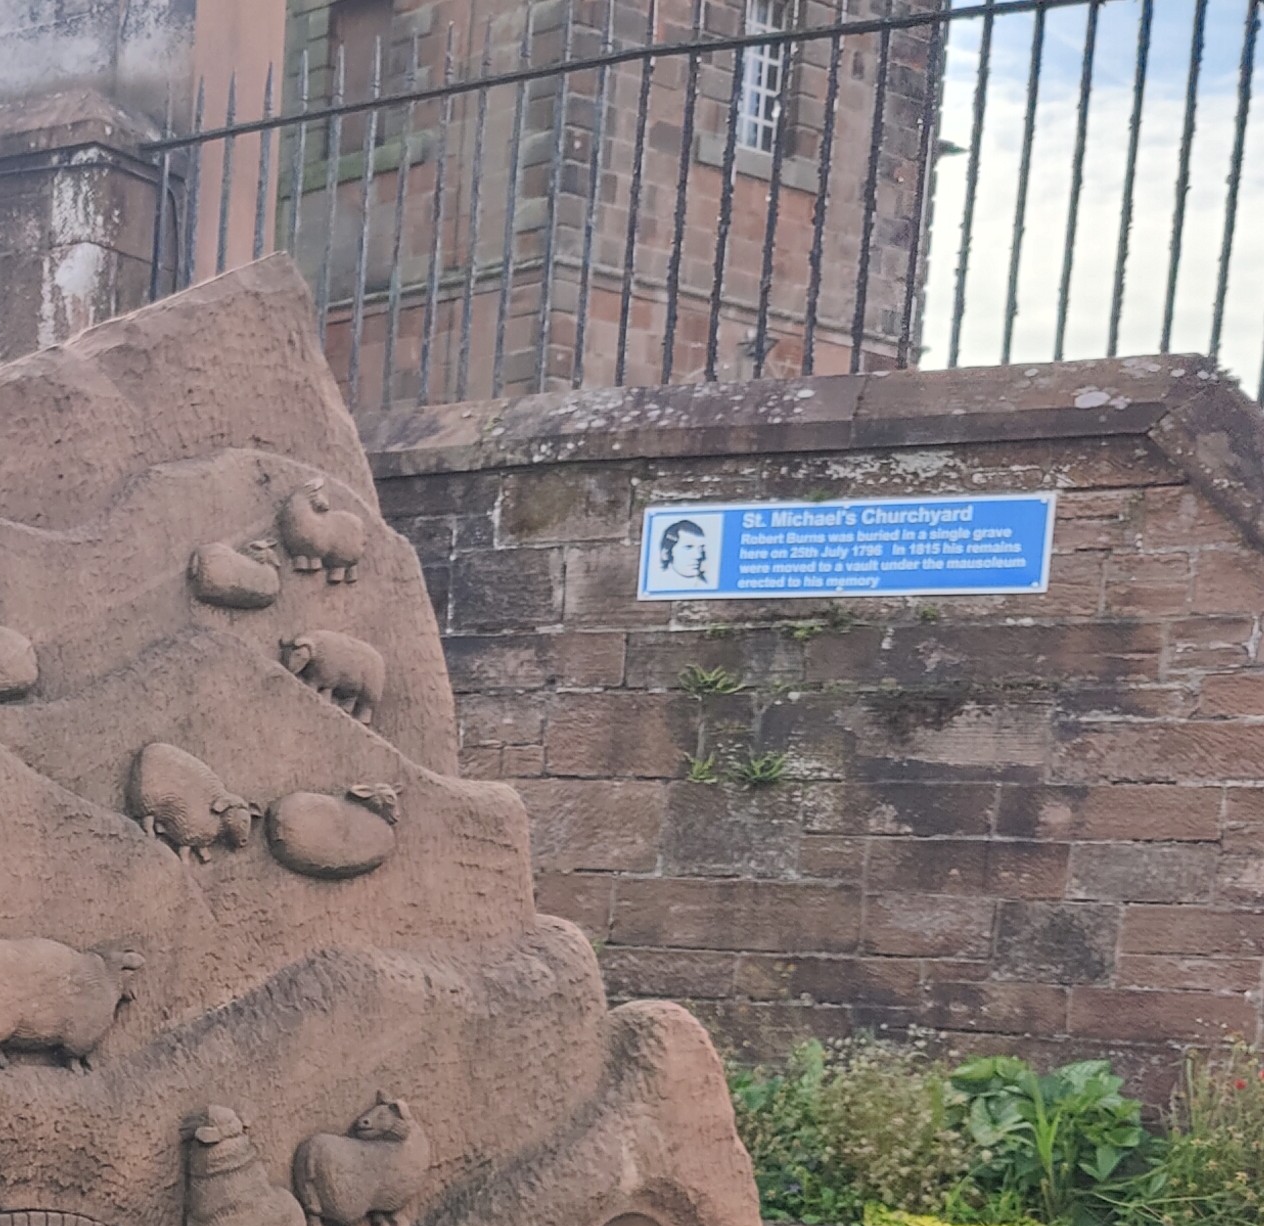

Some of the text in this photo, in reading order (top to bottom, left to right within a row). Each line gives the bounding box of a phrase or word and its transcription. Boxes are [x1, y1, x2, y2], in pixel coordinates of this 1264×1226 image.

[771, 508, 857, 528] Michael's
[861, 504, 974, 526] Churchyard
[740, 527, 1013, 545] Robert Burns was buried in a single grave
[739, 547, 768, 560] here
[770, 548, 788, 559] on
[790, 546, 819, 559] 25th
[821, 545, 849, 560] July
[892, 543, 906, 556] In
[909, 542, 941, 555] 1815
[942, 542, 964, 554] his
[966, 541, 1022, 553] remains
[739, 556, 1027, 574] were moved to a vault under the mausoleum
[737, 575, 881, 589] erected to his memory
